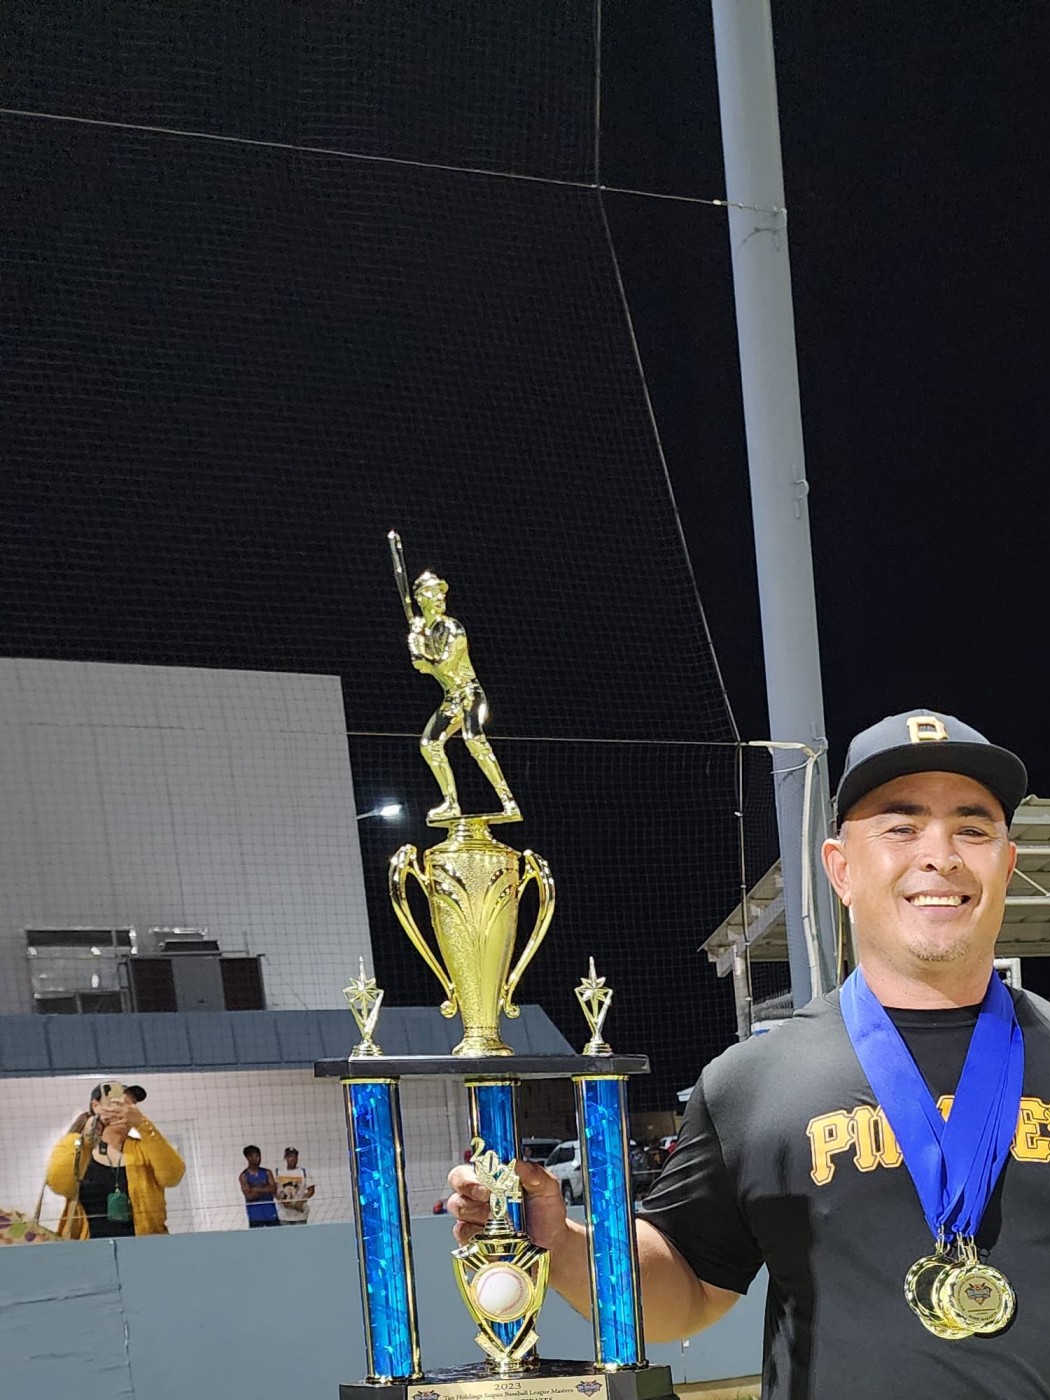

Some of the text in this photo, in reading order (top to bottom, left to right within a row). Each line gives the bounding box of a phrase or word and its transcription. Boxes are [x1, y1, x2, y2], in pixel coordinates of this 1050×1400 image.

[494, 1382, 522, 1391] 2023
[504, 1389, 528, 1397] Baseball
[529, 1388, 550, 1397] League
[551, 1386, 574, 1394] Masters
